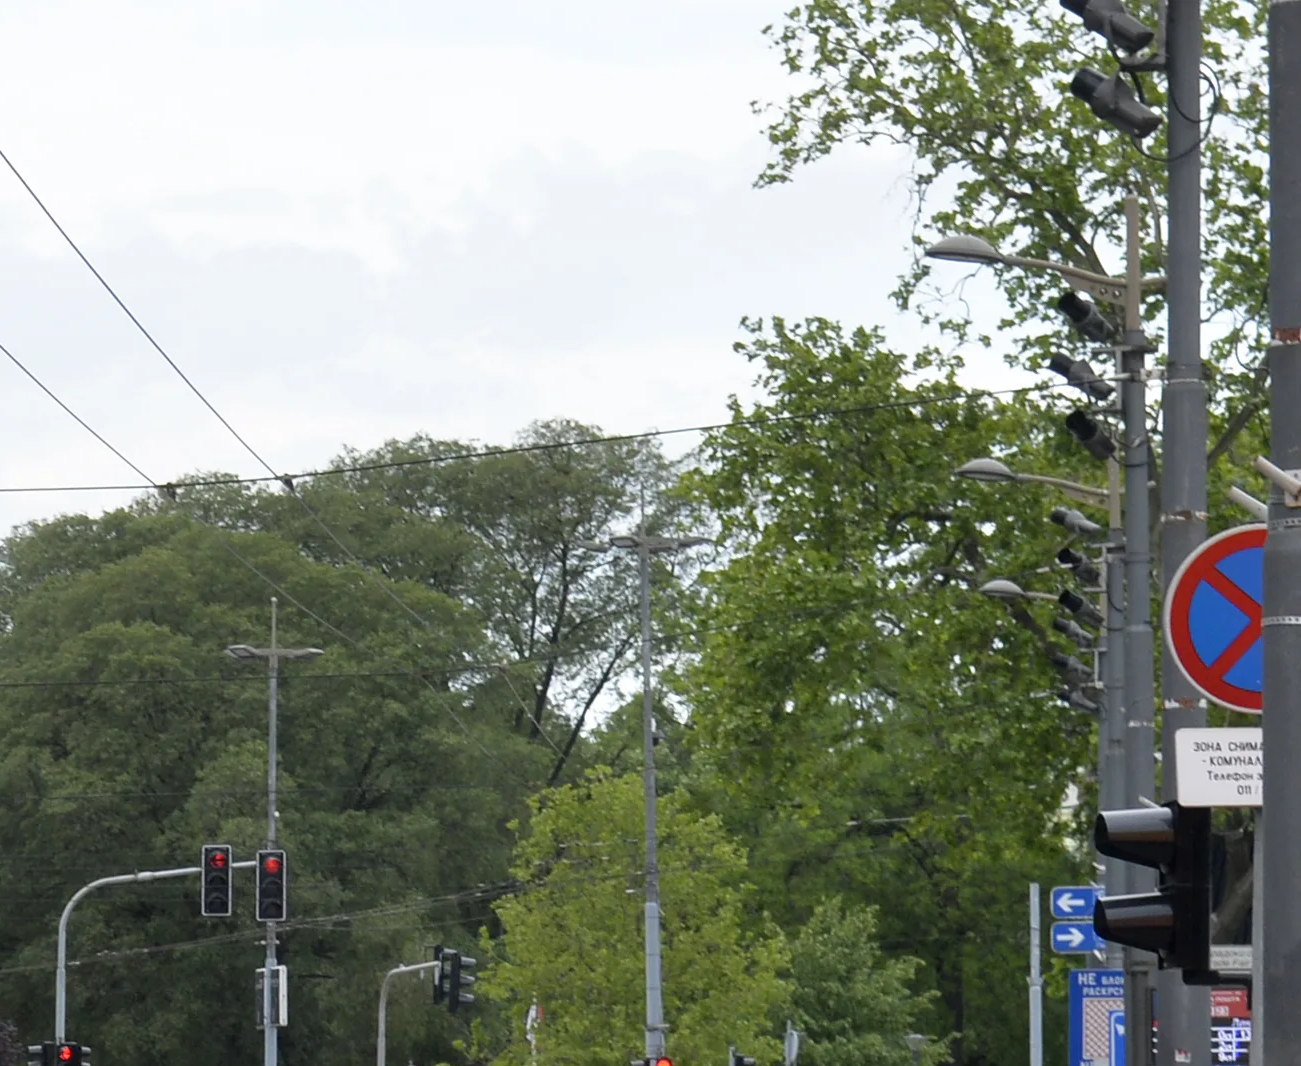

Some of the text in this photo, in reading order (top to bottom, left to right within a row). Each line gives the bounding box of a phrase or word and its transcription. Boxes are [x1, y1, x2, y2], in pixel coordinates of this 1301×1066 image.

[1193, 742, 1222, 752] ЗОНА
[1207, 770, 1254, 781] Телефон
[1078, 972, 1097, 985] НЕ
